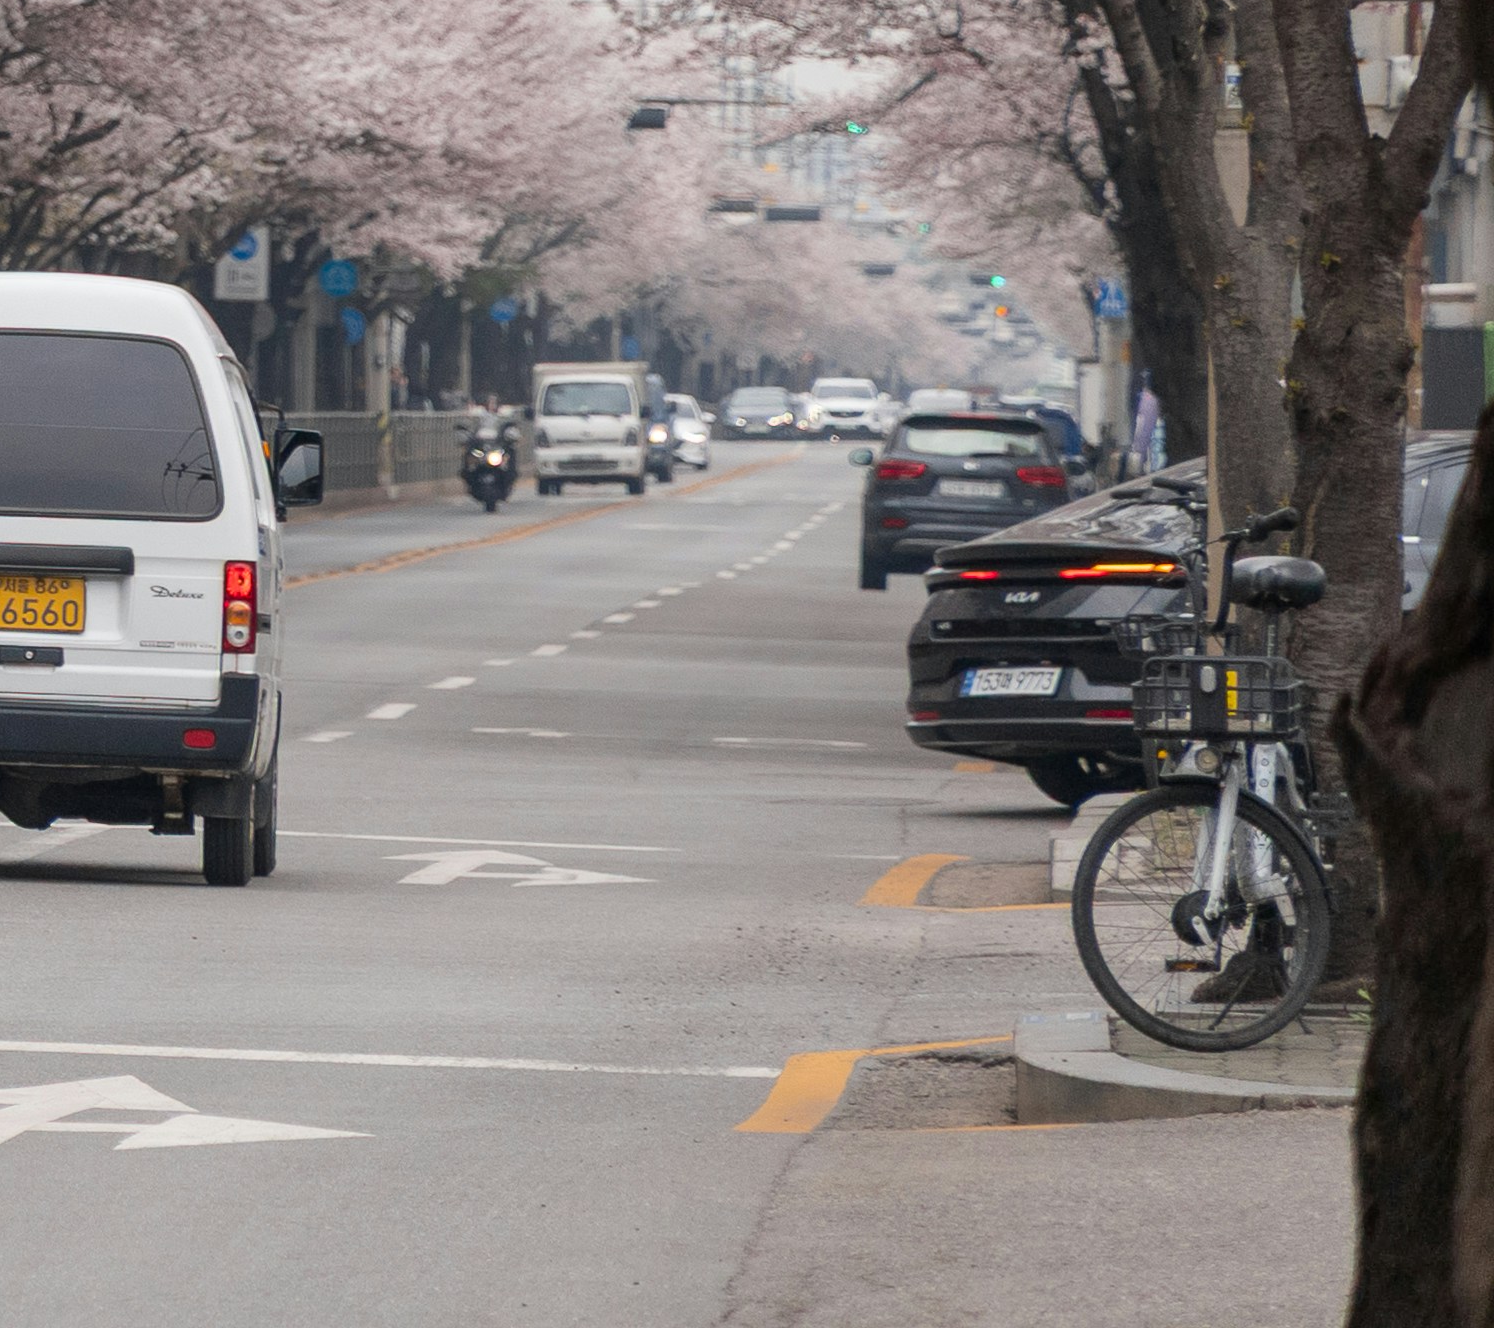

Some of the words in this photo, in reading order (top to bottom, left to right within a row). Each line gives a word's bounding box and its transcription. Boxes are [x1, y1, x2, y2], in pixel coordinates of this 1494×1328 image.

[4, 578, 29, 593] 서울
[34, 578, 58, 594] 86
[150, 585, 204, 599] Deluxe
